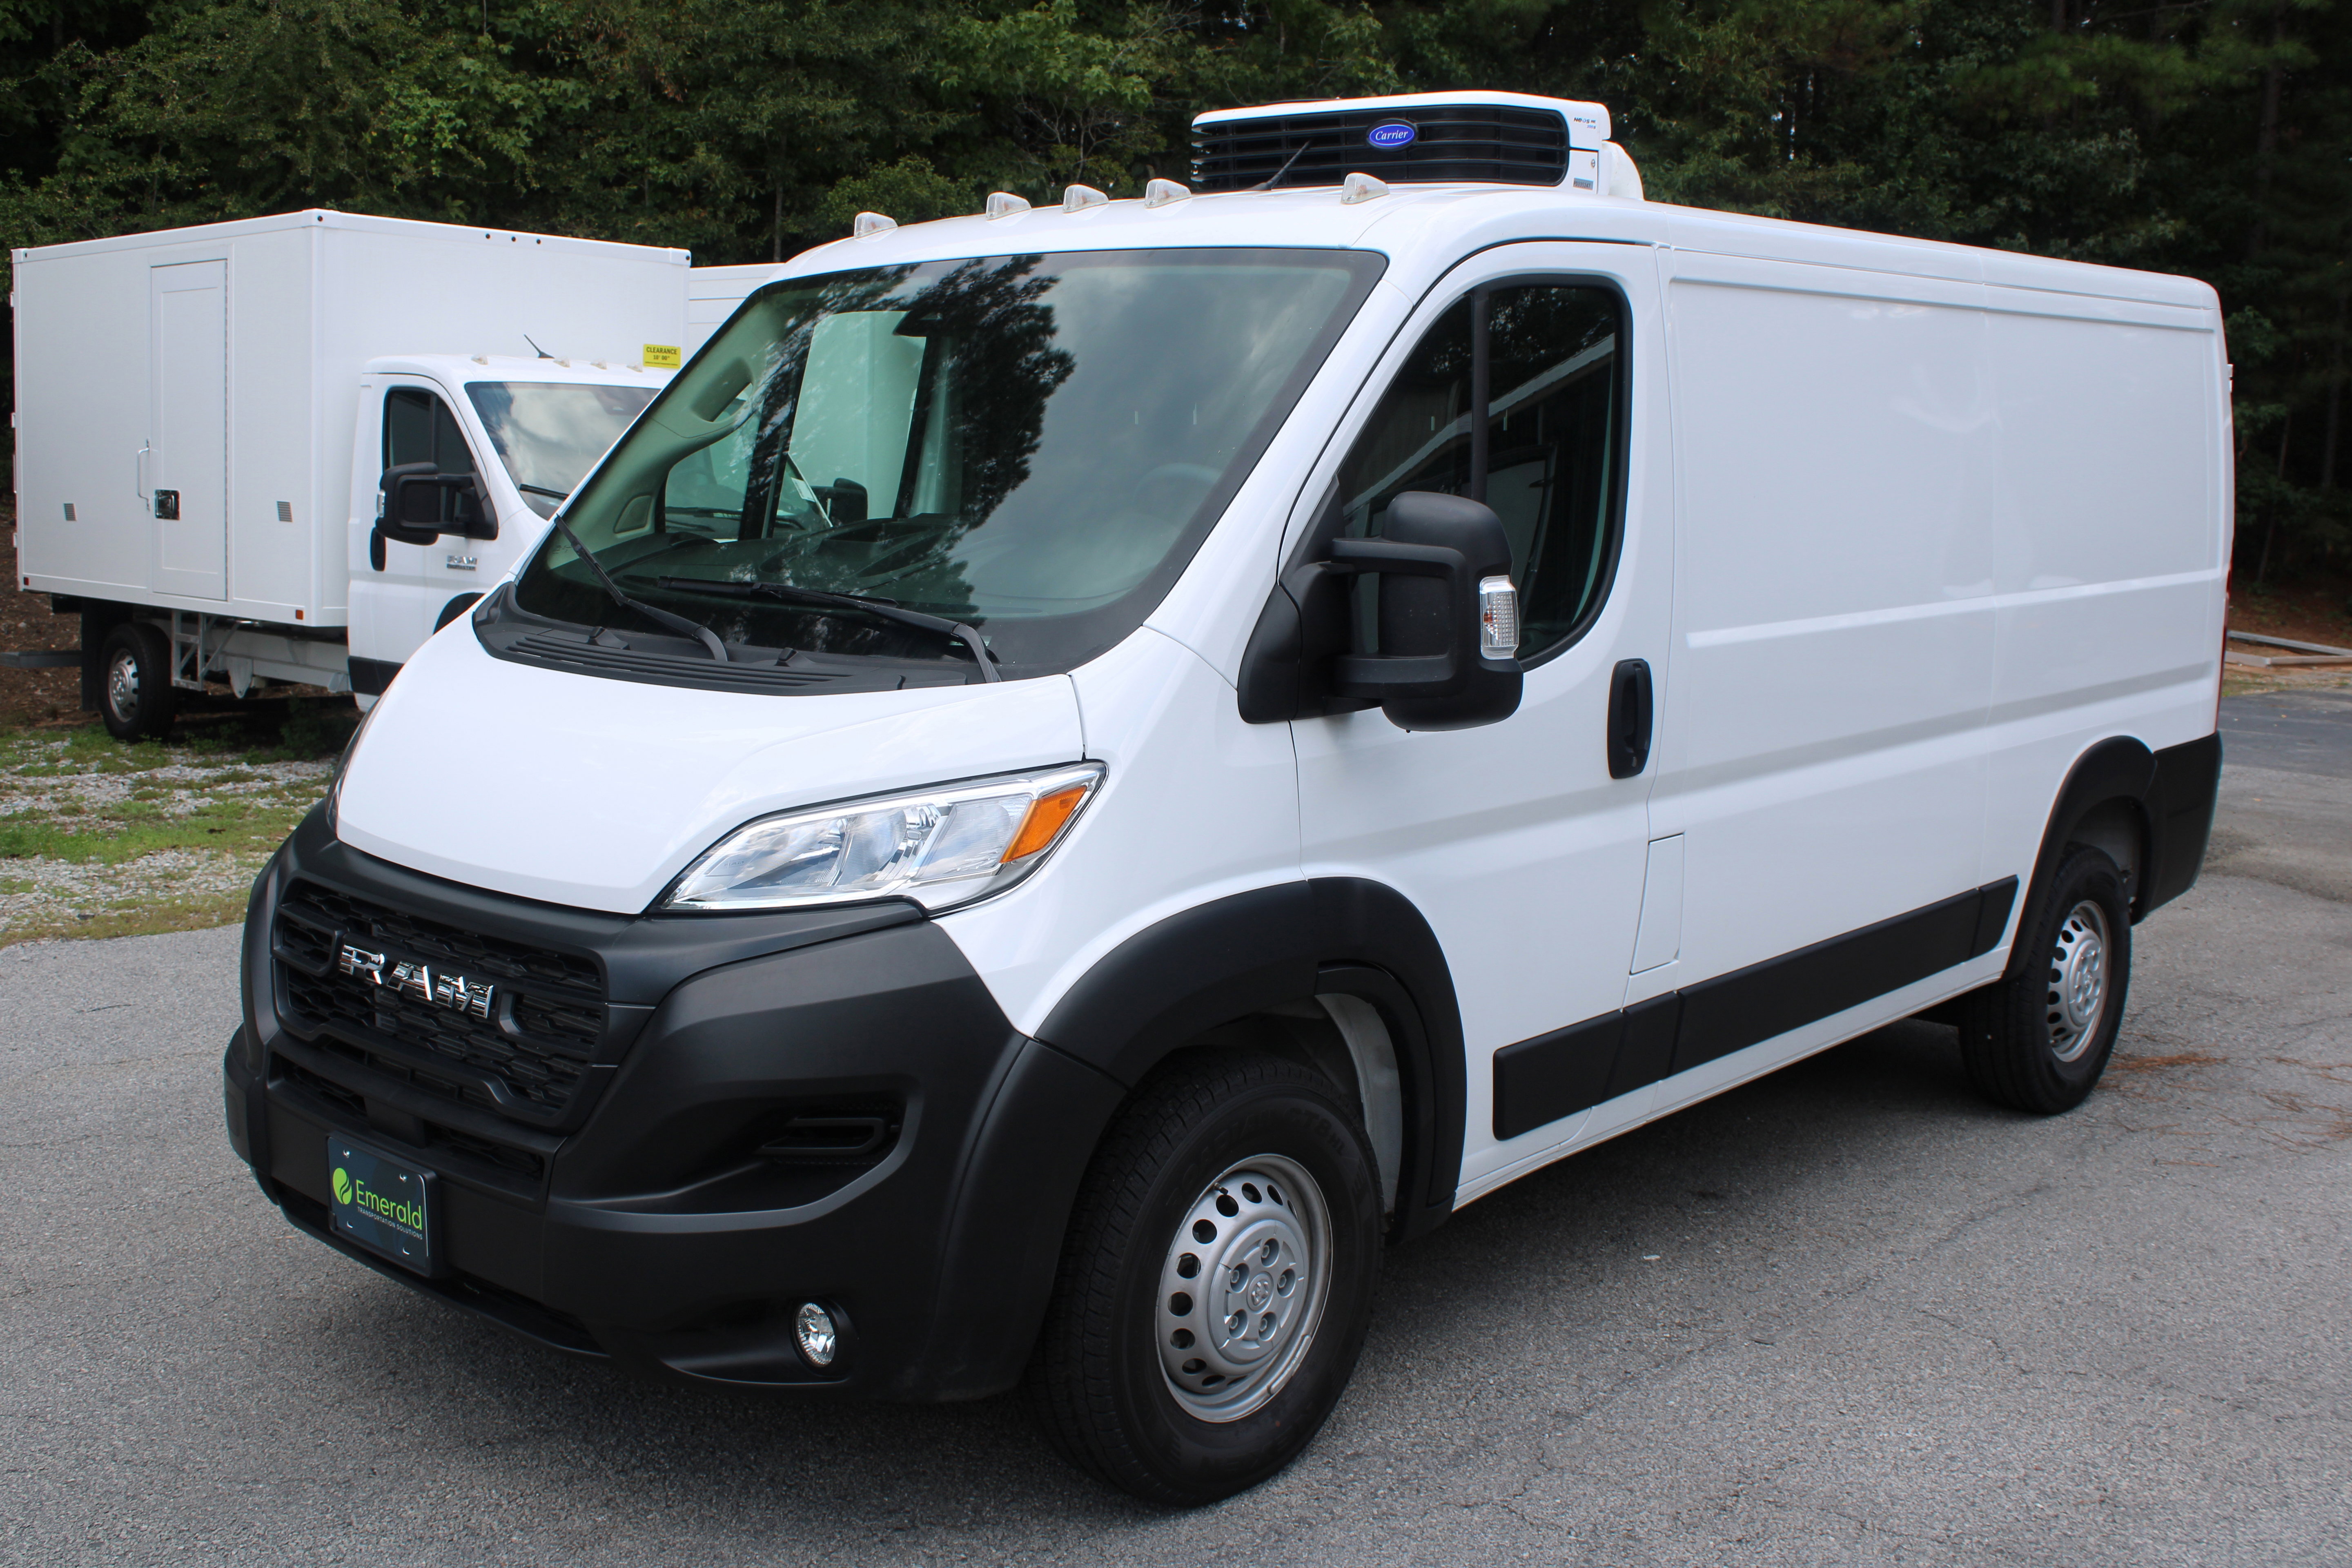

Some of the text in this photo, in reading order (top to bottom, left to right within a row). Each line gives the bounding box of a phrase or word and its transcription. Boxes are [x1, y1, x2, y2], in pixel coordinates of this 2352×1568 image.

[1375, 130, 1408, 140] Carrier
[646, 346, 677, 354] CLEARANCE
[447, 555, 477, 564] RAM
[339, 944, 494, 1018] RAM
[356, 1179, 422, 1230] Emerald
[357, 1206, 423, 1240] TRANSPORTATION SOLUTIONS
